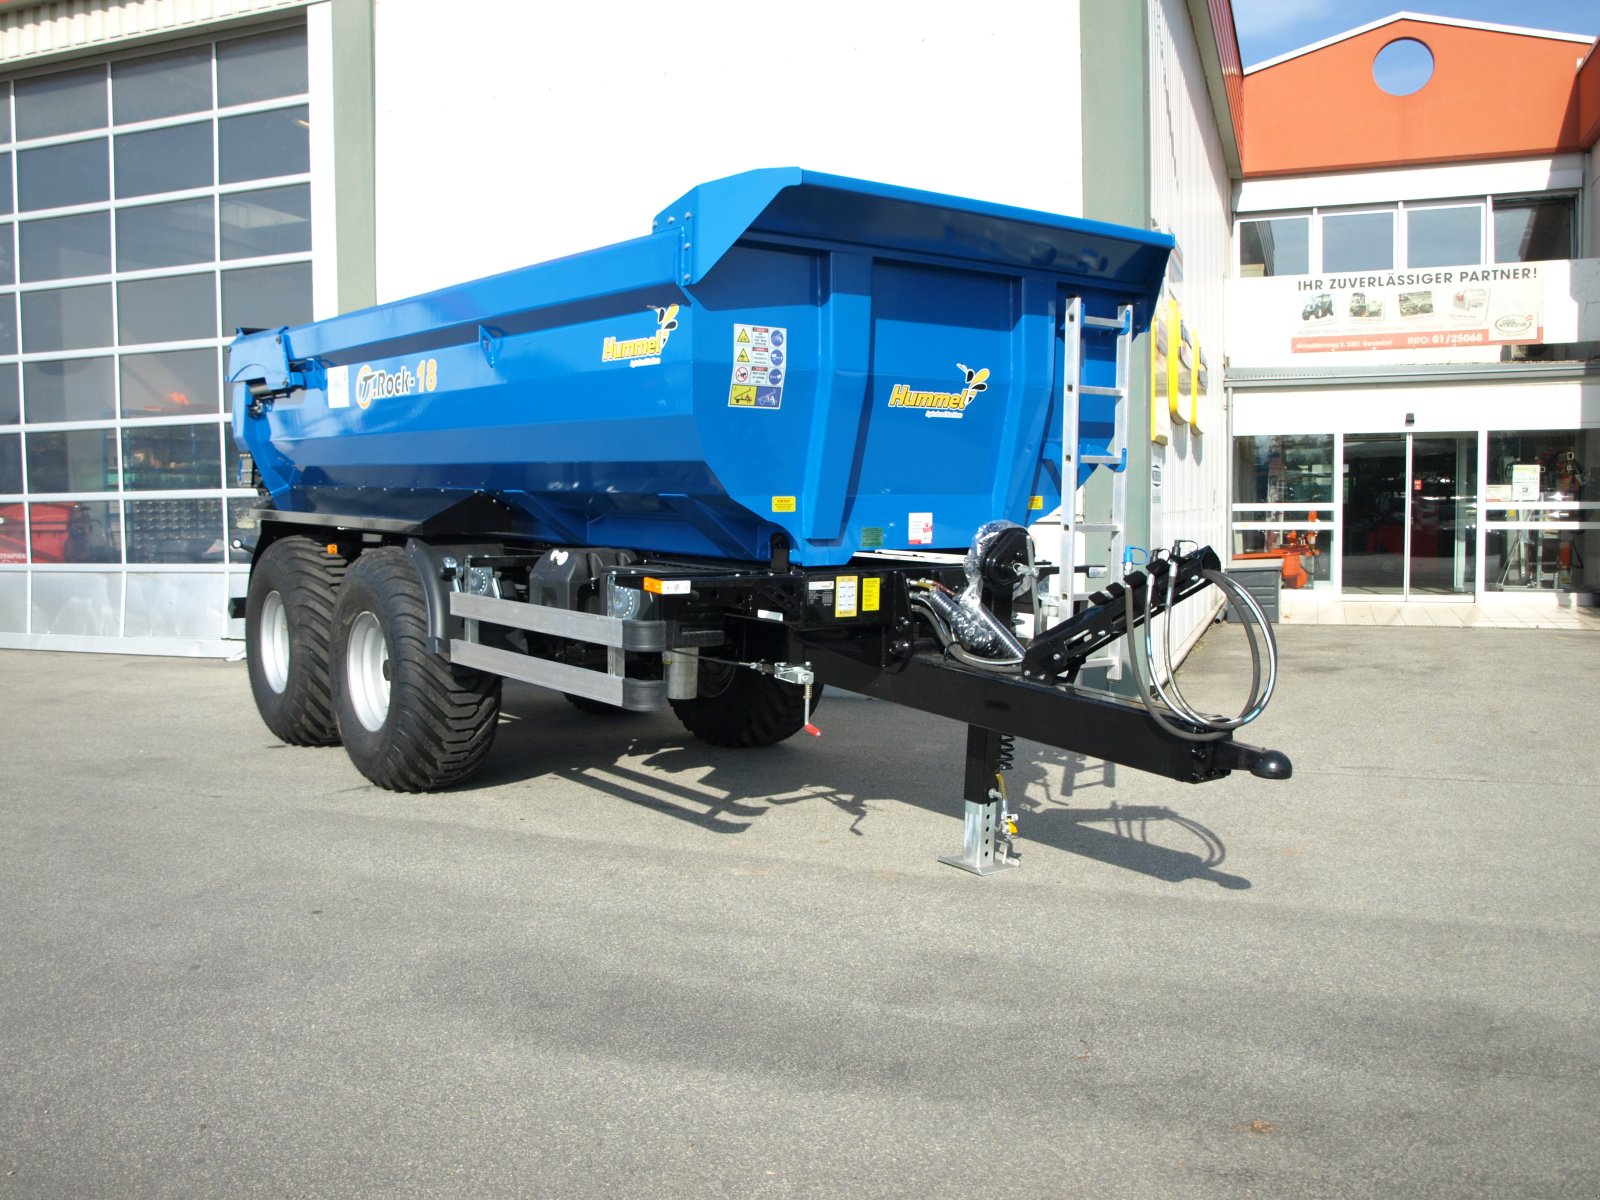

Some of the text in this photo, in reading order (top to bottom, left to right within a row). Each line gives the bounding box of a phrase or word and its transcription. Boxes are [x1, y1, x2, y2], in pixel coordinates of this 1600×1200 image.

[1298, 267, 1537, 291] IHR ZUVERLÄSSIGER PARTNER!
[603, 331, 661, 361] Hummel
[889, 385, 968, 410] Hummel
